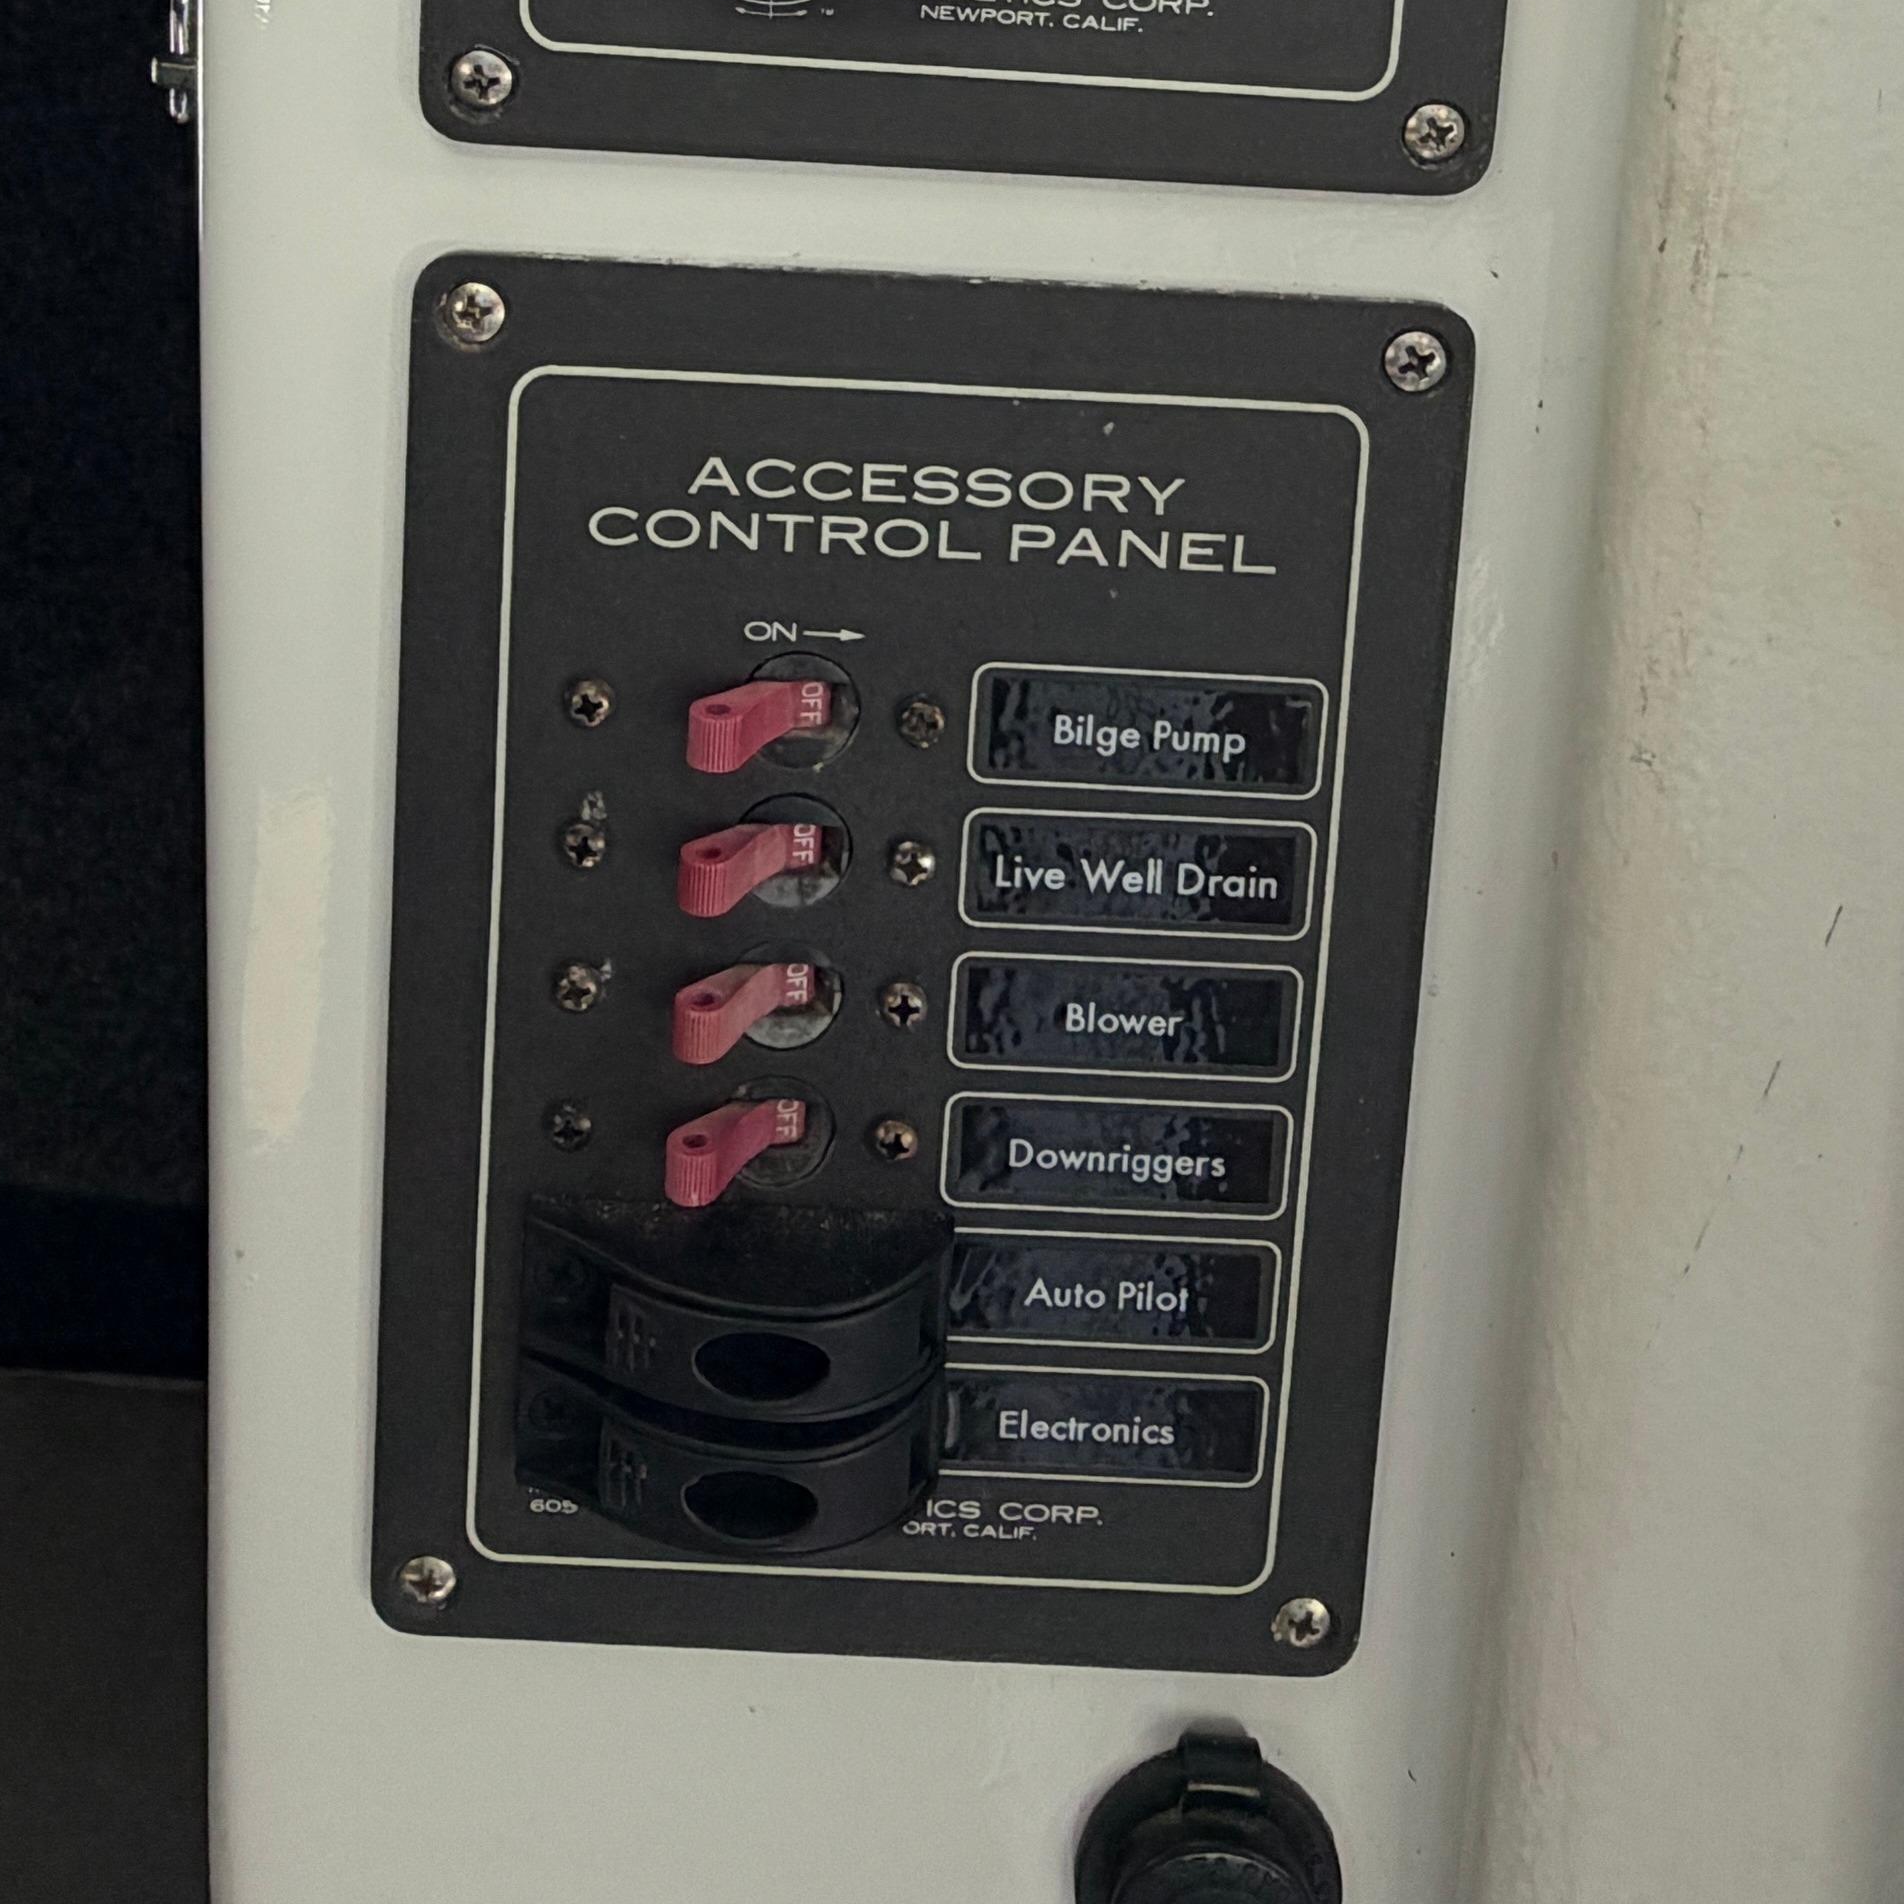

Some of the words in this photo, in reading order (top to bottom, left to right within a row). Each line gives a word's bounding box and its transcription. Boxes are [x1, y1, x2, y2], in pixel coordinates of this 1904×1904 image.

[1063, 14, 1142, 32] CALIF.
[689, 456, 1186, 516] ACCESSORY
[589, 507, 981, 559] CONTROL
[1010, 524, 1276, 574] PANEL
[744, 622, 796, 641] ON
[799, 681, 824, 725] OFF
[1055, 715, 1140, 756] Bilge
[1154, 721, 1245, 762] Pump
[792, 824, 816, 864] OFF
[996, 855, 1065, 889] Live
[1081, 858, 1162, 894] Well
[1178, 863, 1277, 898] Drain
[786, 964, 809, 1003] OFF
[1066, 1002, 1182, 1035] Blower
[776, 1099, 800, 1140] OFF
[1010, 1139, 1224, 1182] Downriggers
[1025, 1278, 1105, 1308] Auto
[1119, 1282, 1188, 1311] Pilot
[1000, 1410, 1174, 1444] Electronics
[531, 1499, 577, 1513] 605
[1000, 1503, 1102, 1524] CORP.
[964, 1524, 1034, 1538] CALIF.
